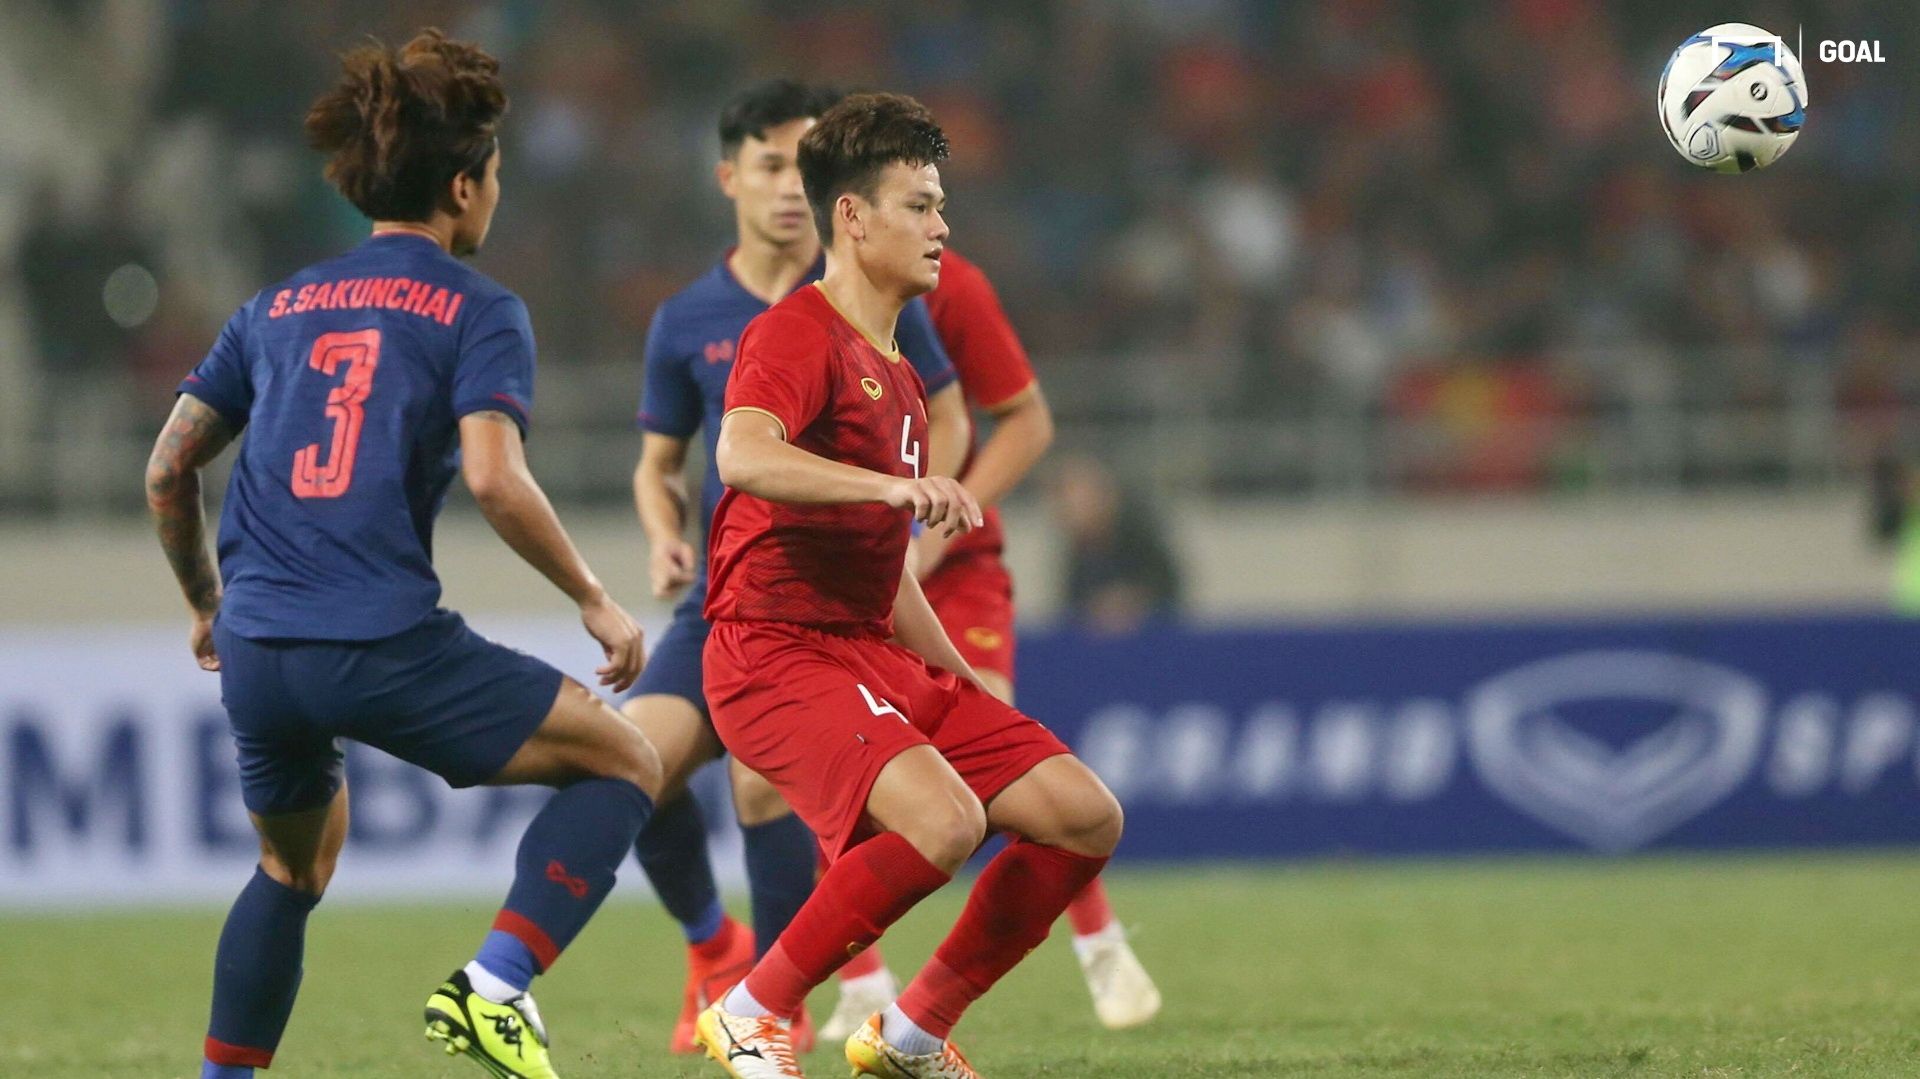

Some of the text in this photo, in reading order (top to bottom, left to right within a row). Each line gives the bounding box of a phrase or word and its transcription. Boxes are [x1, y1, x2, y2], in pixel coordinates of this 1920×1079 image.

[268, 276, 464, 326] S.SAKUNCHAI
[290, 328, 381, 498] 3
[900, 414, 921, 480] 4
[856, 683, 909, 725] 4
